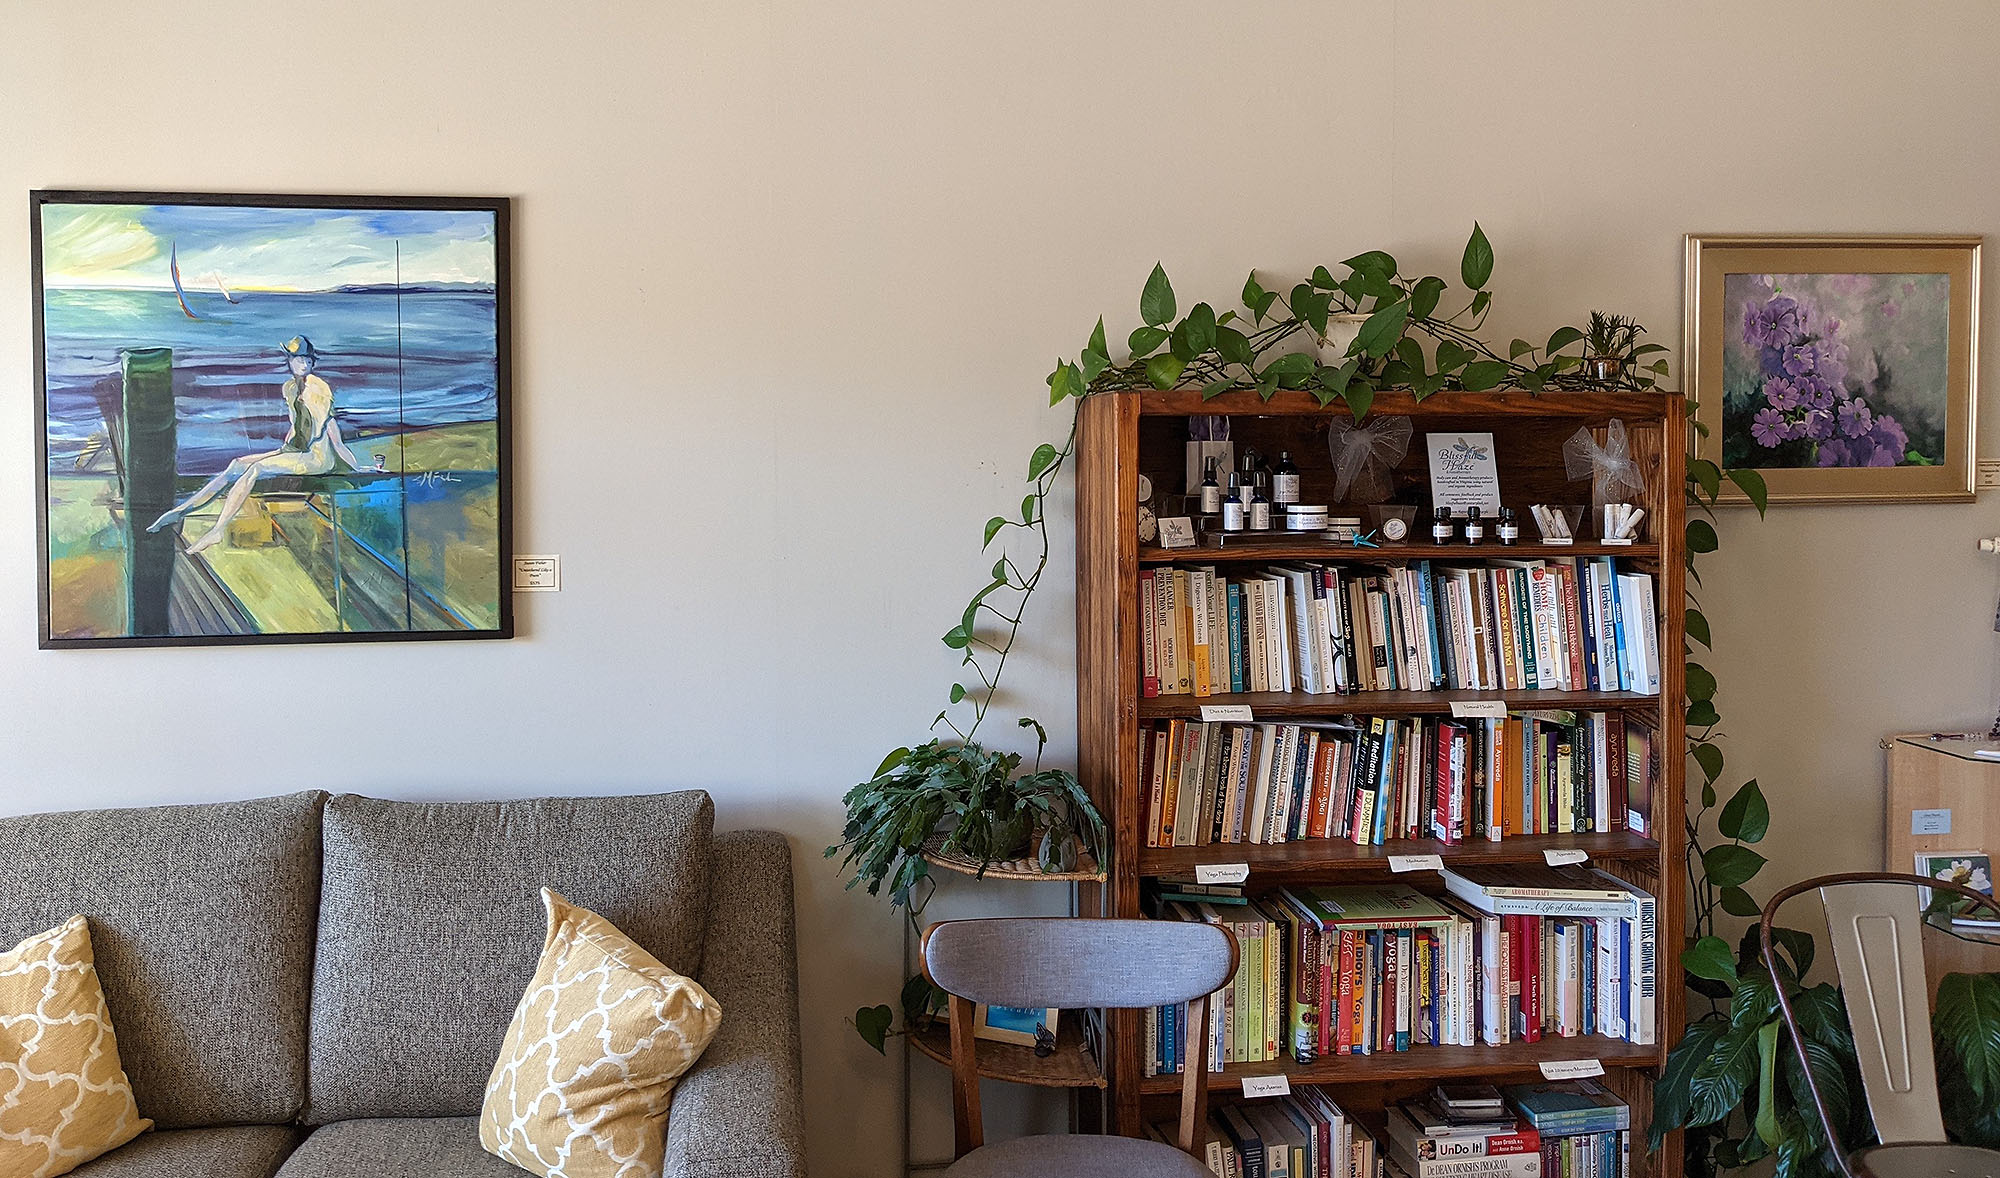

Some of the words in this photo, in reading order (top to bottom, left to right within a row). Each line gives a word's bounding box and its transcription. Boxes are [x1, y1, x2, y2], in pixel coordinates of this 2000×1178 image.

[1158, 573, 1166, 611] PREVENTION
[1205, 570, 1214, 593] Fortify
[1601, 584, 1610, 609] Herbs
[1231, 606, 1239, 616] The
[1498, 584, 1507, 618] Software
[1504, 646, 1513, 666] Mind
[1566, 596, 1575, 630] ARTHRITIS
[1197, 613, 1205, 643] Wellness
[1232, 619, 1240, 651] Vegetarian
[1538, 614, 1548, 659] Children
[1603, 620, 1613, 639] Heal
[1234, 653, 1242, 676] Traveler
[1368, 740, 1379, 784] Meditation
[1610, 733, 1619, 777] ayurveda
[1238, 771, 1246, 793] SOUL
[1564, 901, 1593, 912] Balance
[1306, 928, 1314, 974] Ashtanga
[1386, 941, 1397, 972] yoga
[1641, 942, 1654, 975] GROWING
[1305, 977, 1313, 1000] Yoga
[1340, 970, 1352, 996] Yoga
[1641, 976, 1654, 998] OLDER
[1353, 996, 1362, 1024] Yoga
[1440, 1144, 1469, 1155] UnDo
[1473, 1143, 1482, 1153] It!
